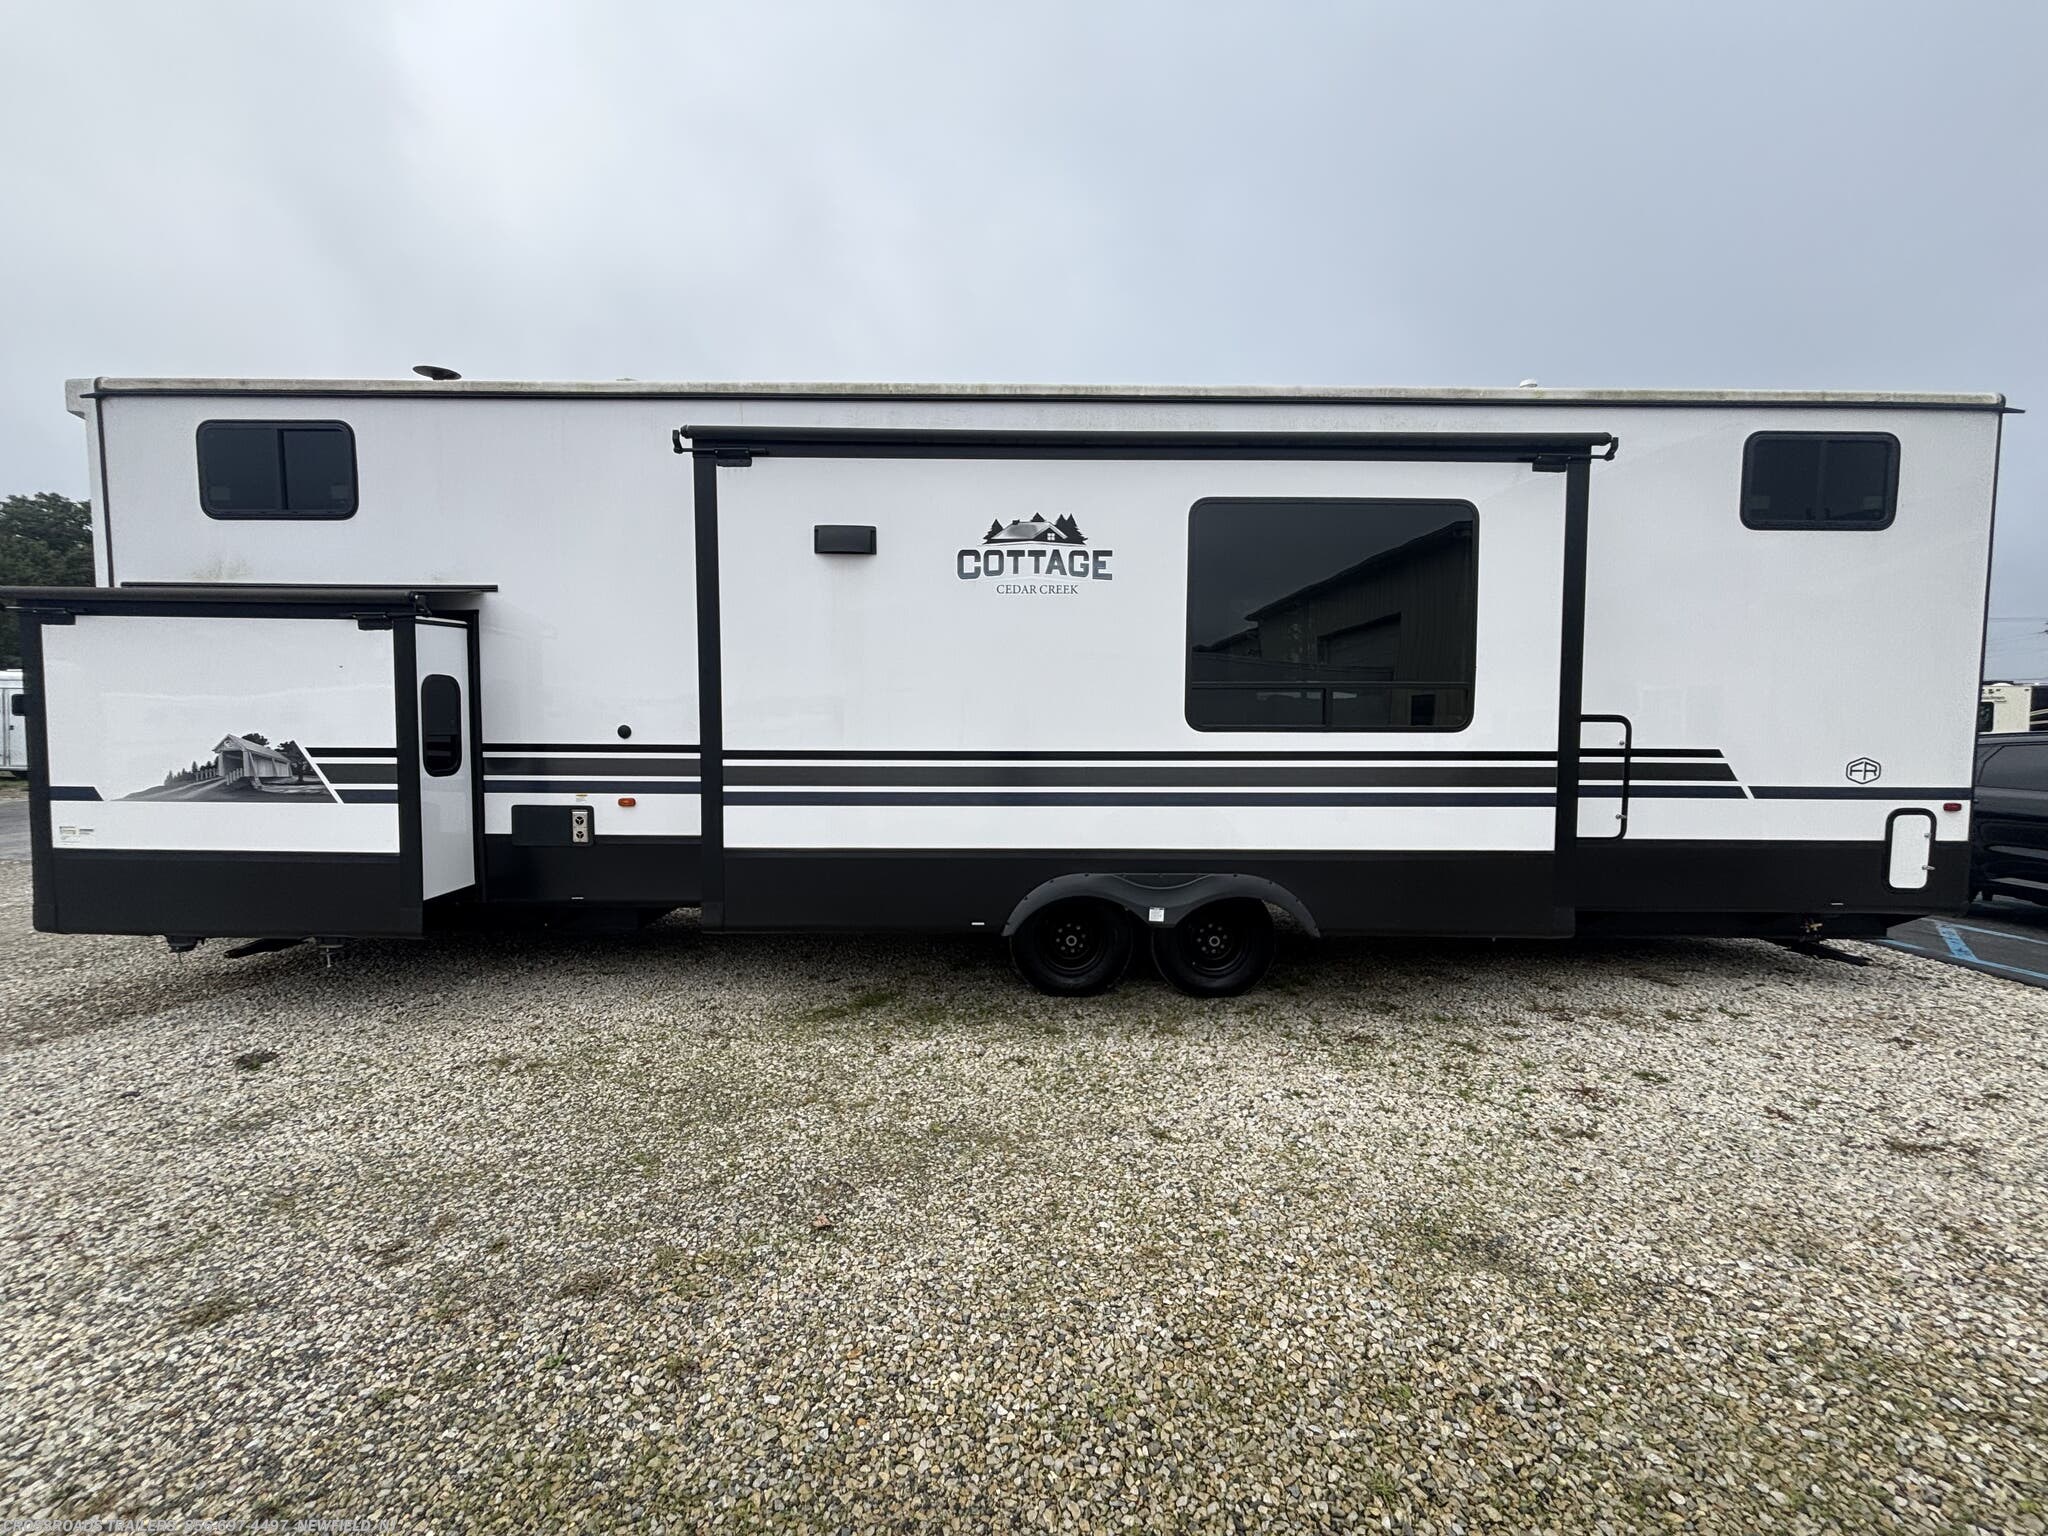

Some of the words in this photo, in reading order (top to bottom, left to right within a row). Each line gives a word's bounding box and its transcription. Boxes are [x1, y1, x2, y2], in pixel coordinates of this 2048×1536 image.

[957, 549, 1113, 581] COTTAGE
[996, 584, 1036, 595] CEDAR
[1039, 584, 1079, 595] CREEK
